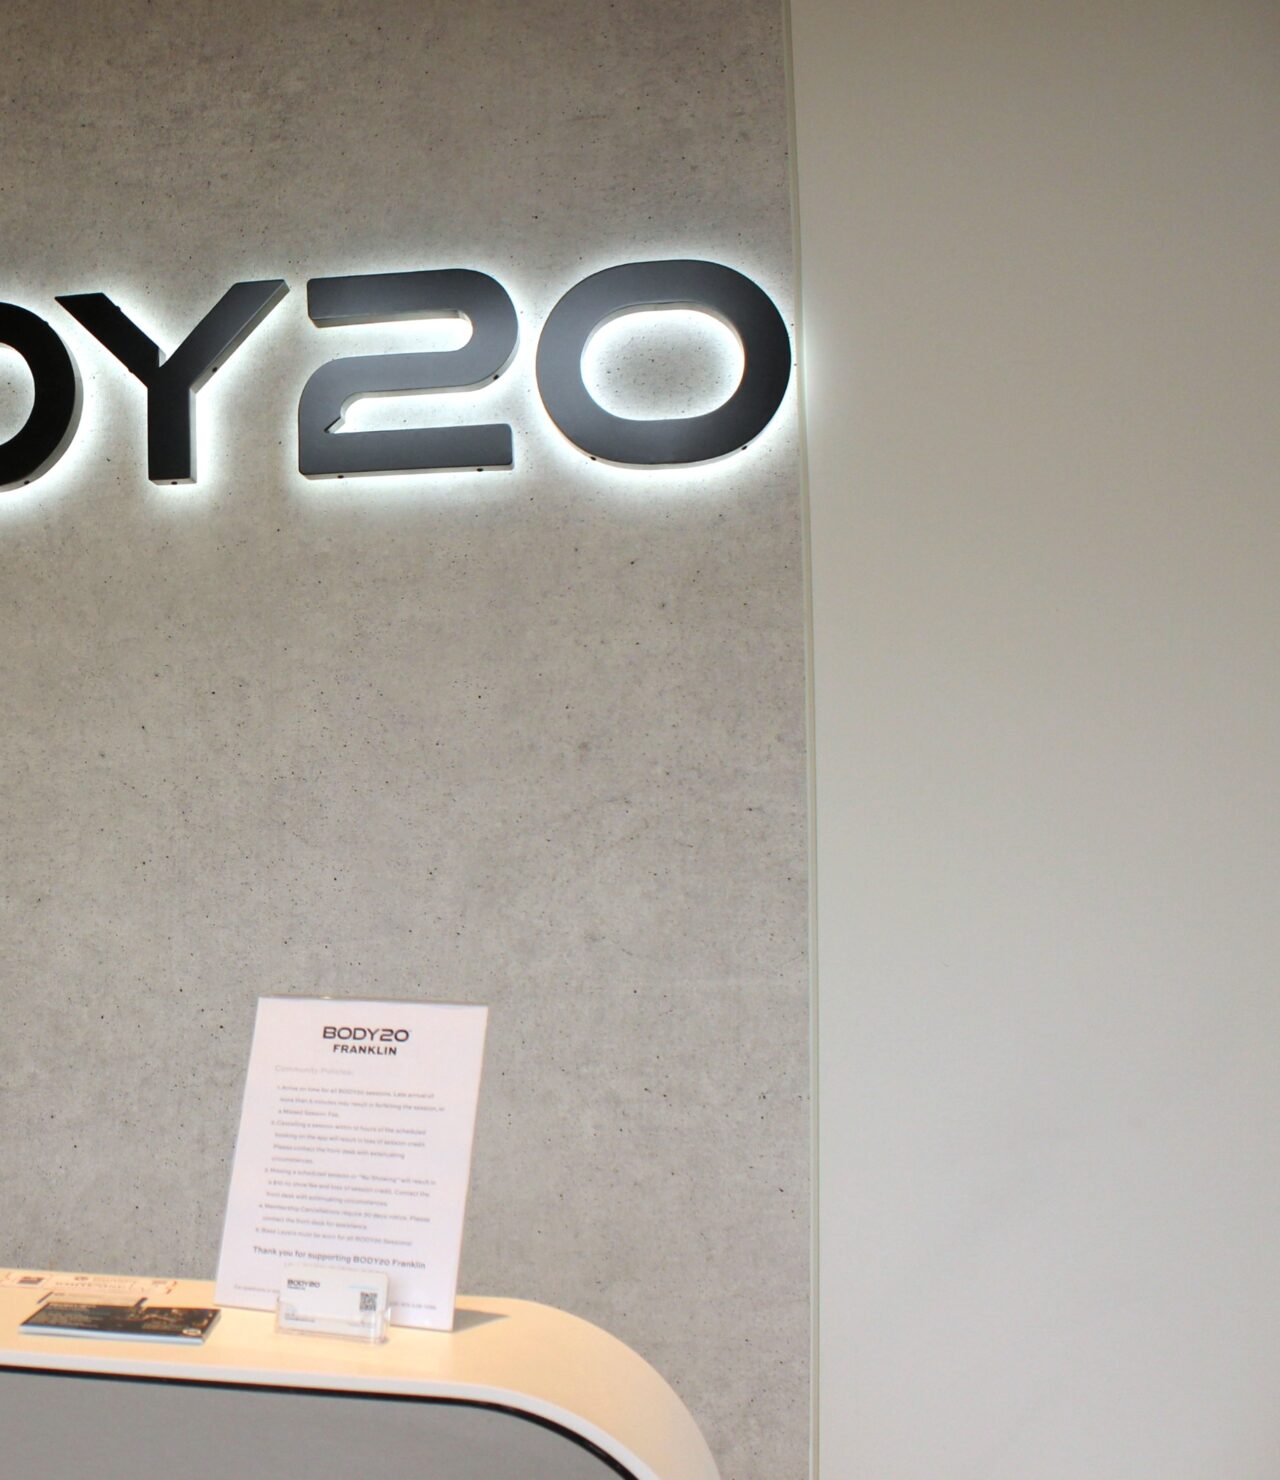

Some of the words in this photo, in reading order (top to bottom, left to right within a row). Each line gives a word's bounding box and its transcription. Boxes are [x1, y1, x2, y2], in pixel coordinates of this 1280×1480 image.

[322, 1026, 410, 1043] BODY20
[332, 1044, 397, 1056] FRANKLIN
[252, 1245, 276, 1255] Thank
[278, 1249, 293, 1259] you
[294, 1249, 306, 1258] for
[307, 1251, 351, 1265] supporting
[352, 1255, 390, 1266] BODY20
[391, 1259, 426, 1270] Franklin
